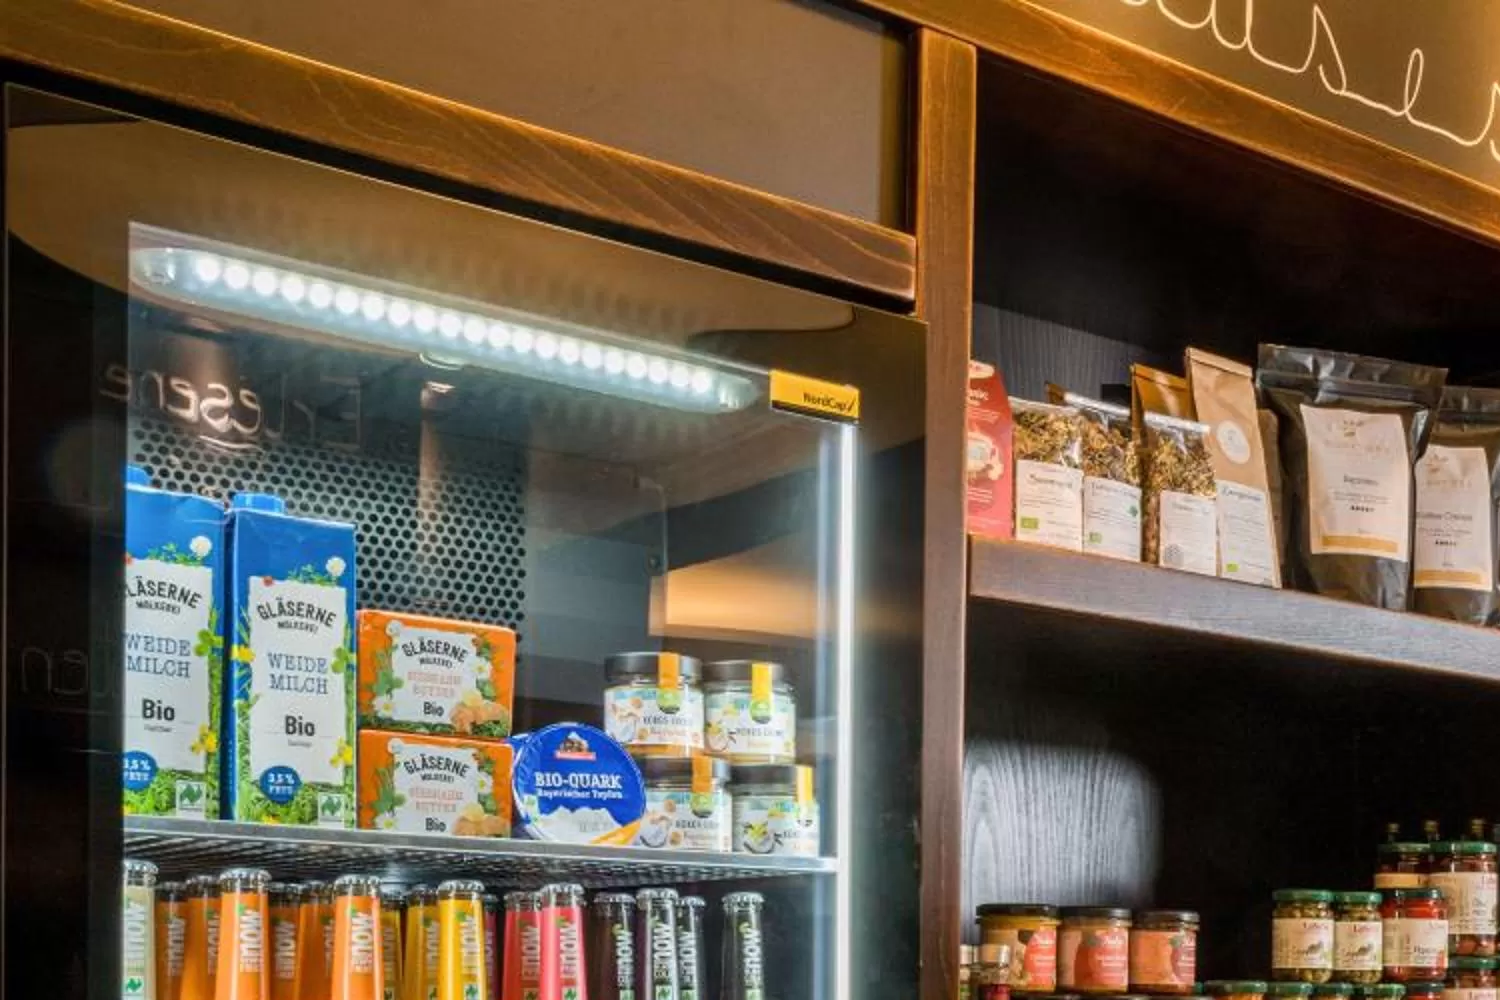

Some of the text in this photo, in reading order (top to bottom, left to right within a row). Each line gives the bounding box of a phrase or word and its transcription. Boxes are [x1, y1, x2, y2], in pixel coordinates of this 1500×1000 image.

[257, 597, 337, 627] GLÄSERNE
[125, 633, 191, 656] WEIDE
[402, 637, 469, 664] GLÄSERNE
[127, 656, 191, 679] MILCH
[267, 652, 328, 673] WEIDE
[269, 673, 328, 694] MILCH
[141, 699, 175, 722] Bio
[423, 701, 445, 717] Bio
[285, 714, 316, 737] Bio
[404, 753, 471, 779] GLÄSERNE
[535, 771, 622, 789] BIO-QUARK
[424, 817, 447, 833] Bio
